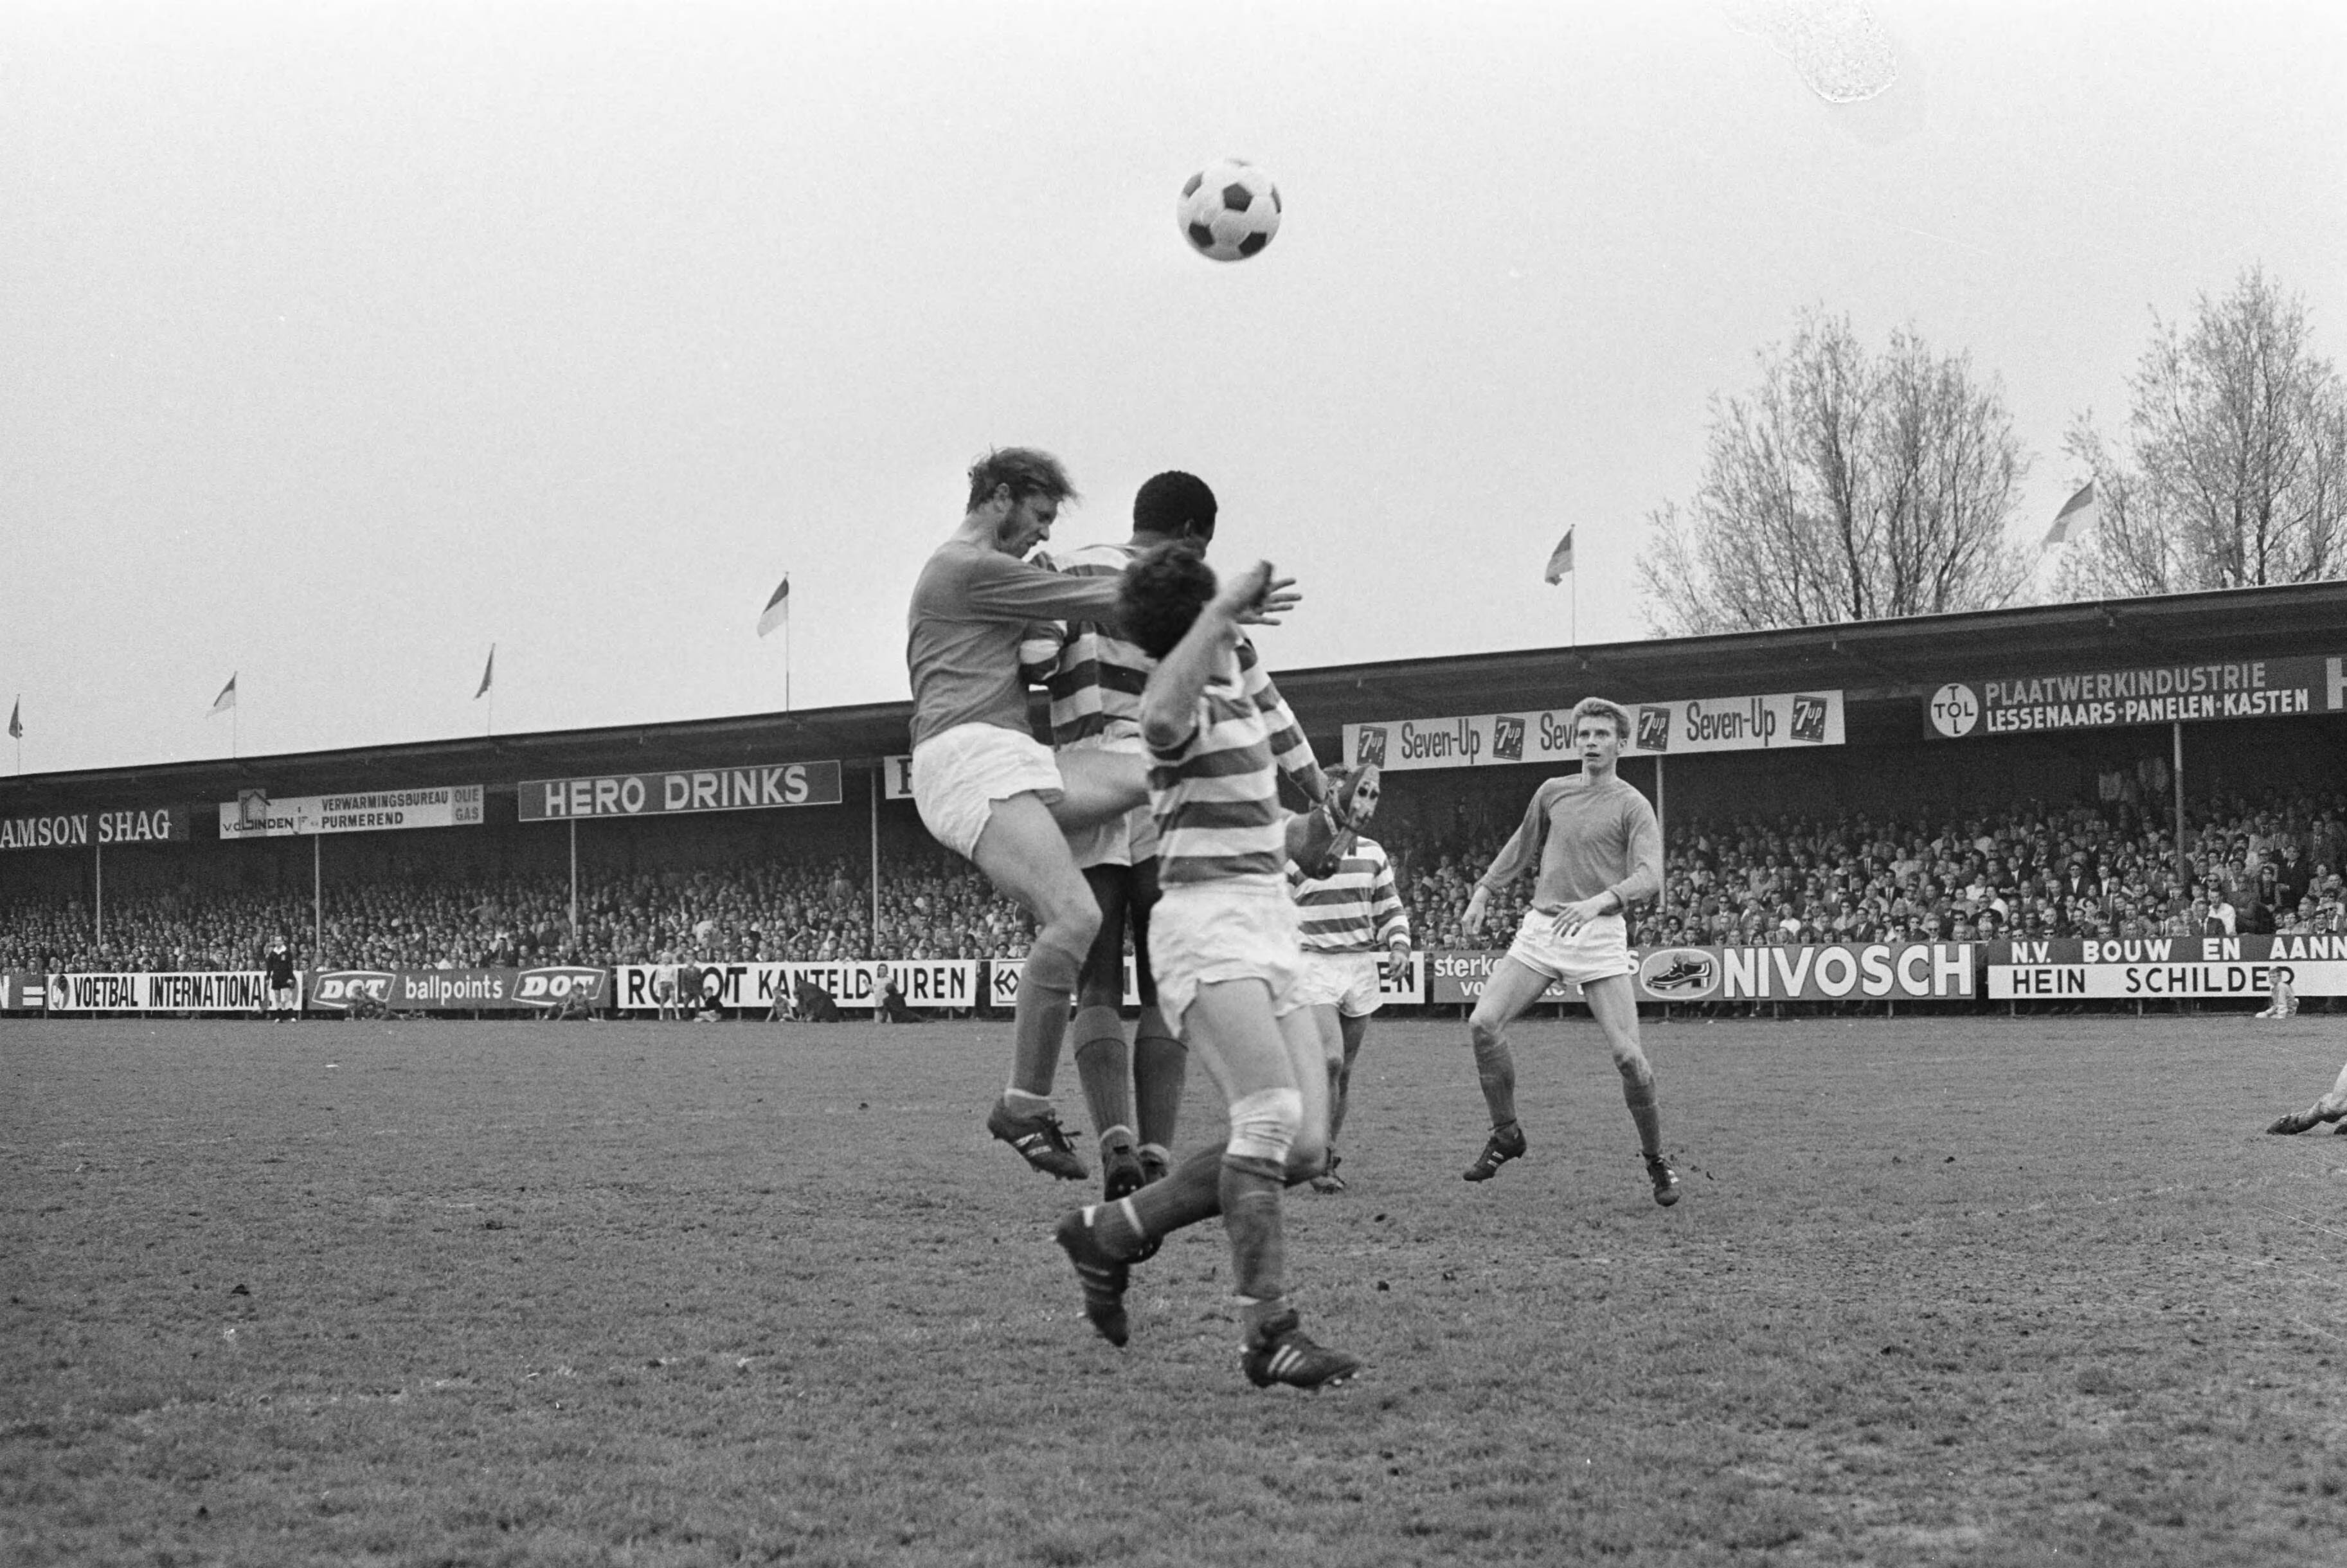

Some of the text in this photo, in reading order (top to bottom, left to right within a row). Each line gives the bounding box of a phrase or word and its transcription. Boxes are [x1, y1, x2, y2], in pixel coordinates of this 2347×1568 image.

[1986, 662, 2265, 706] PLAATWERKINDUSTRIE
[2224, 688, 2308, 716] KASTEN
[1686, 698, 1776, 747] Seven-Up
[1401, 718, 1480, 765] Seven-Up
[321, 791, 448, 812] VERWARMINGSBUREAU
[545, 765, 810, 816] HERO DRINKS
[98, 809, 170, 843] SHAG
[321, 811, 404, 829] PURMEREND
[455, 806, 480, 821] GAS
[2082, 939, 2172, 962] BOUW
[2202, 937, 2240, 960] EN
[520, 975, 595, 996] DOT
[759, 967, 965, 999] KANTELDUREN
[1723, 943, 1972, 998] NIVOSCH
[2013, 969, 2085, 994] HEIN
[74, 975, 272, 1007] VOETBAL INTERNATIONA
[320, 978, 386, 998] DOT
[406, 975, 503, 1005] ballpoints
